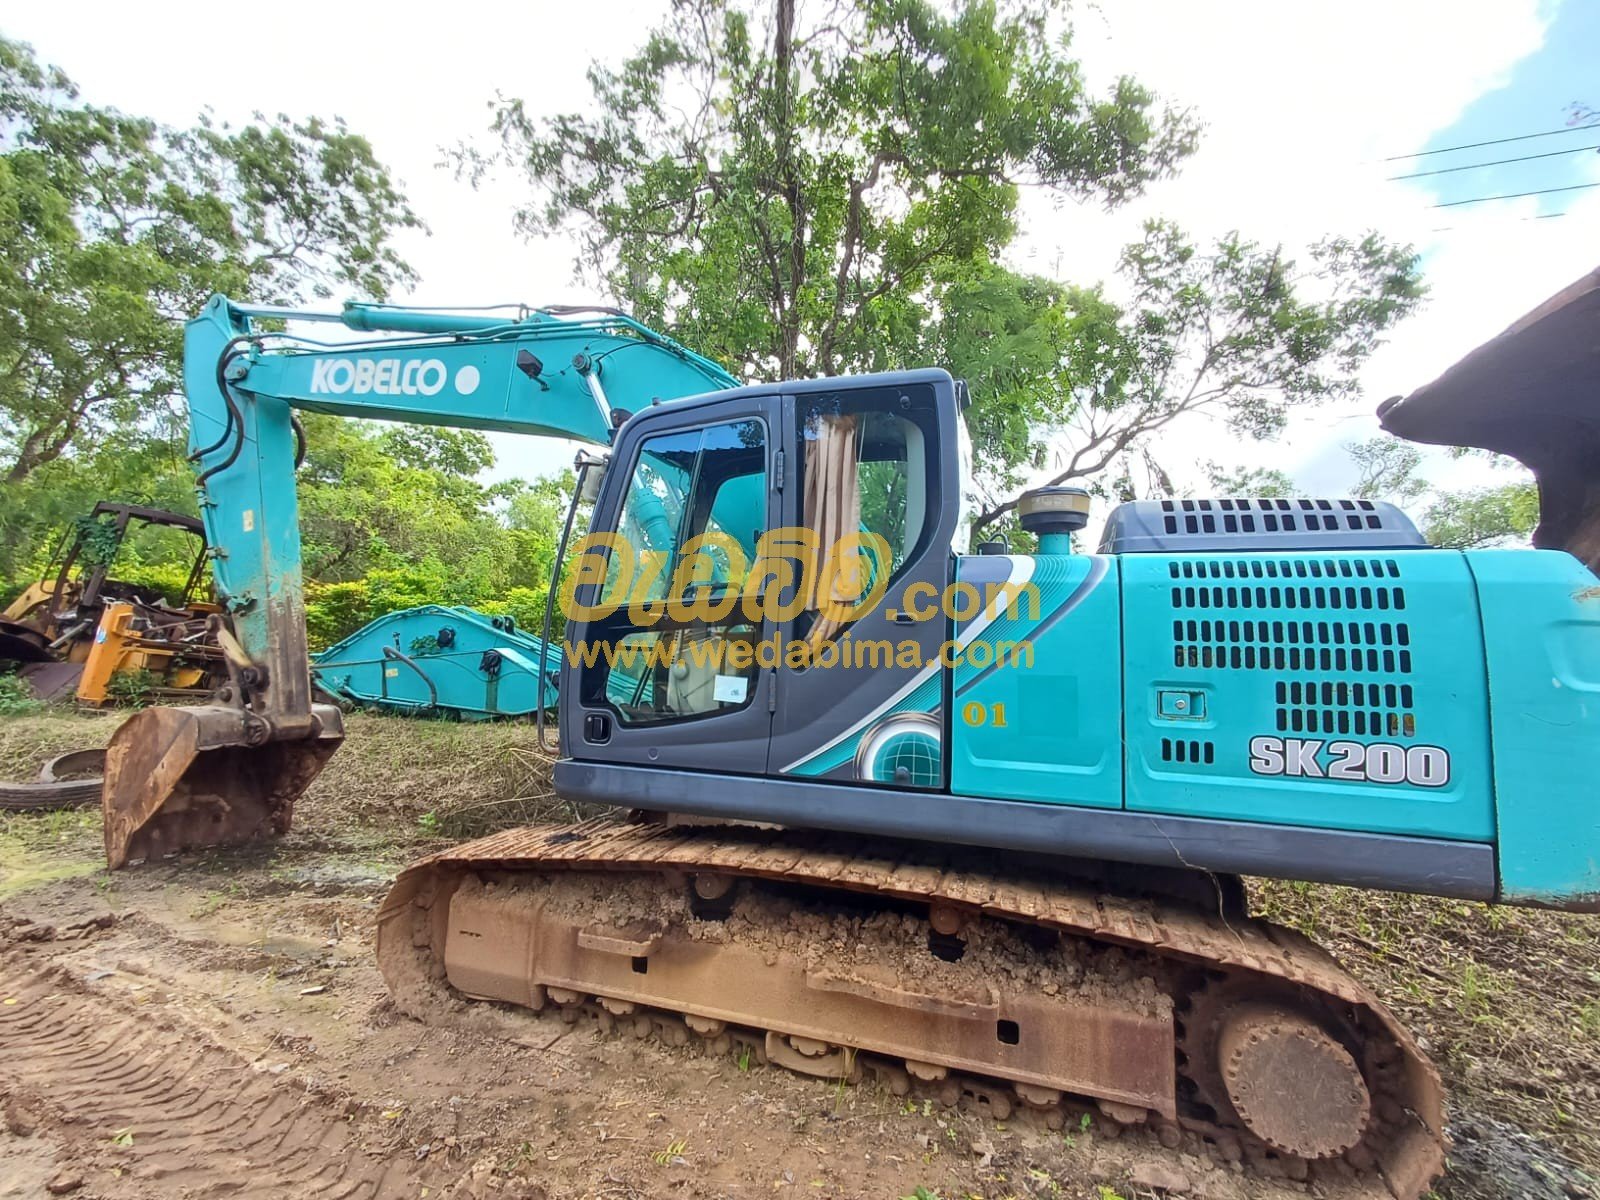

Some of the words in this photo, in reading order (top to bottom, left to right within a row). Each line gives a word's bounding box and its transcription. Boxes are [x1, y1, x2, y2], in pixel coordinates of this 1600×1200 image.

[311, 359, 447, 396] KOBELCO
[962, 701, 1008, 727] 01
[1250, 736, 1450, 787] SK200
